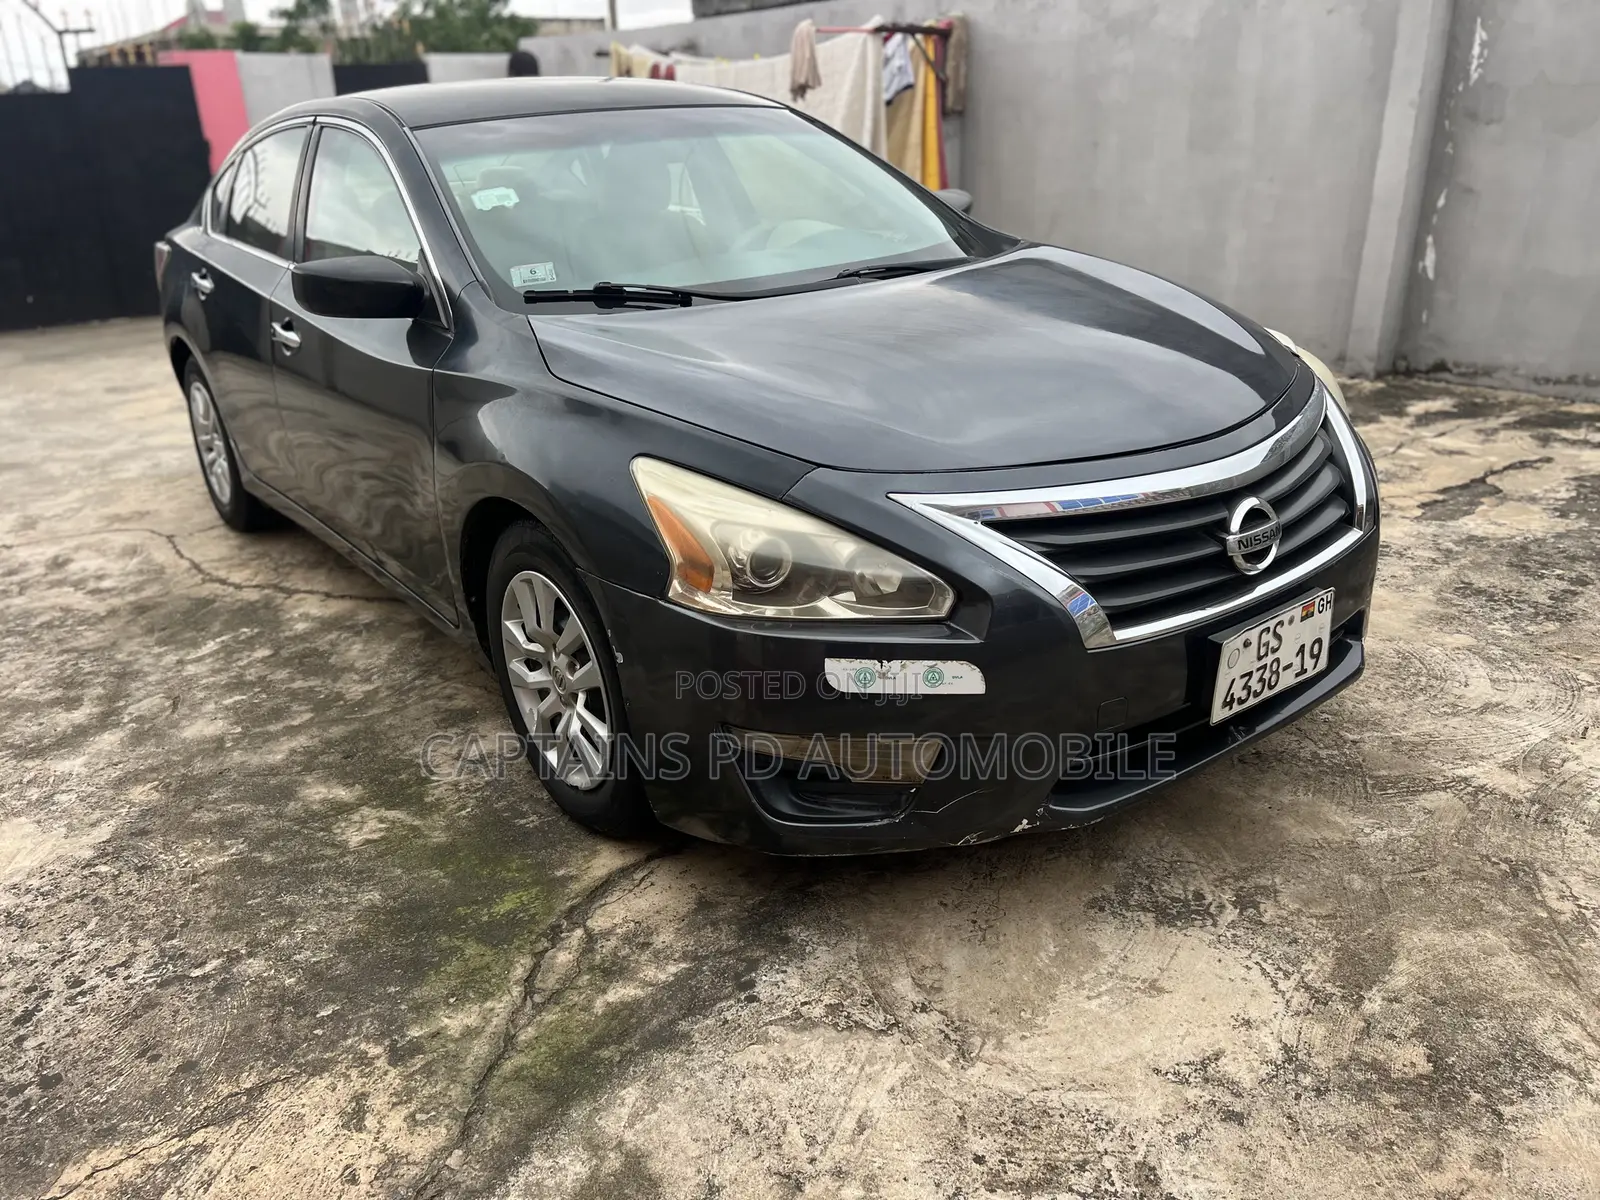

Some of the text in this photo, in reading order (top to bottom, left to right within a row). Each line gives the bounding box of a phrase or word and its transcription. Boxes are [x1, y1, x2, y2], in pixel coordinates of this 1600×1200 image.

[1238, 524, 1281, 551] NISSAN
[1317, 593, 1332, 614] GH
[1256, 619, 1285, 662] GS
[1221, 636, 1323, 711] 4338-19
